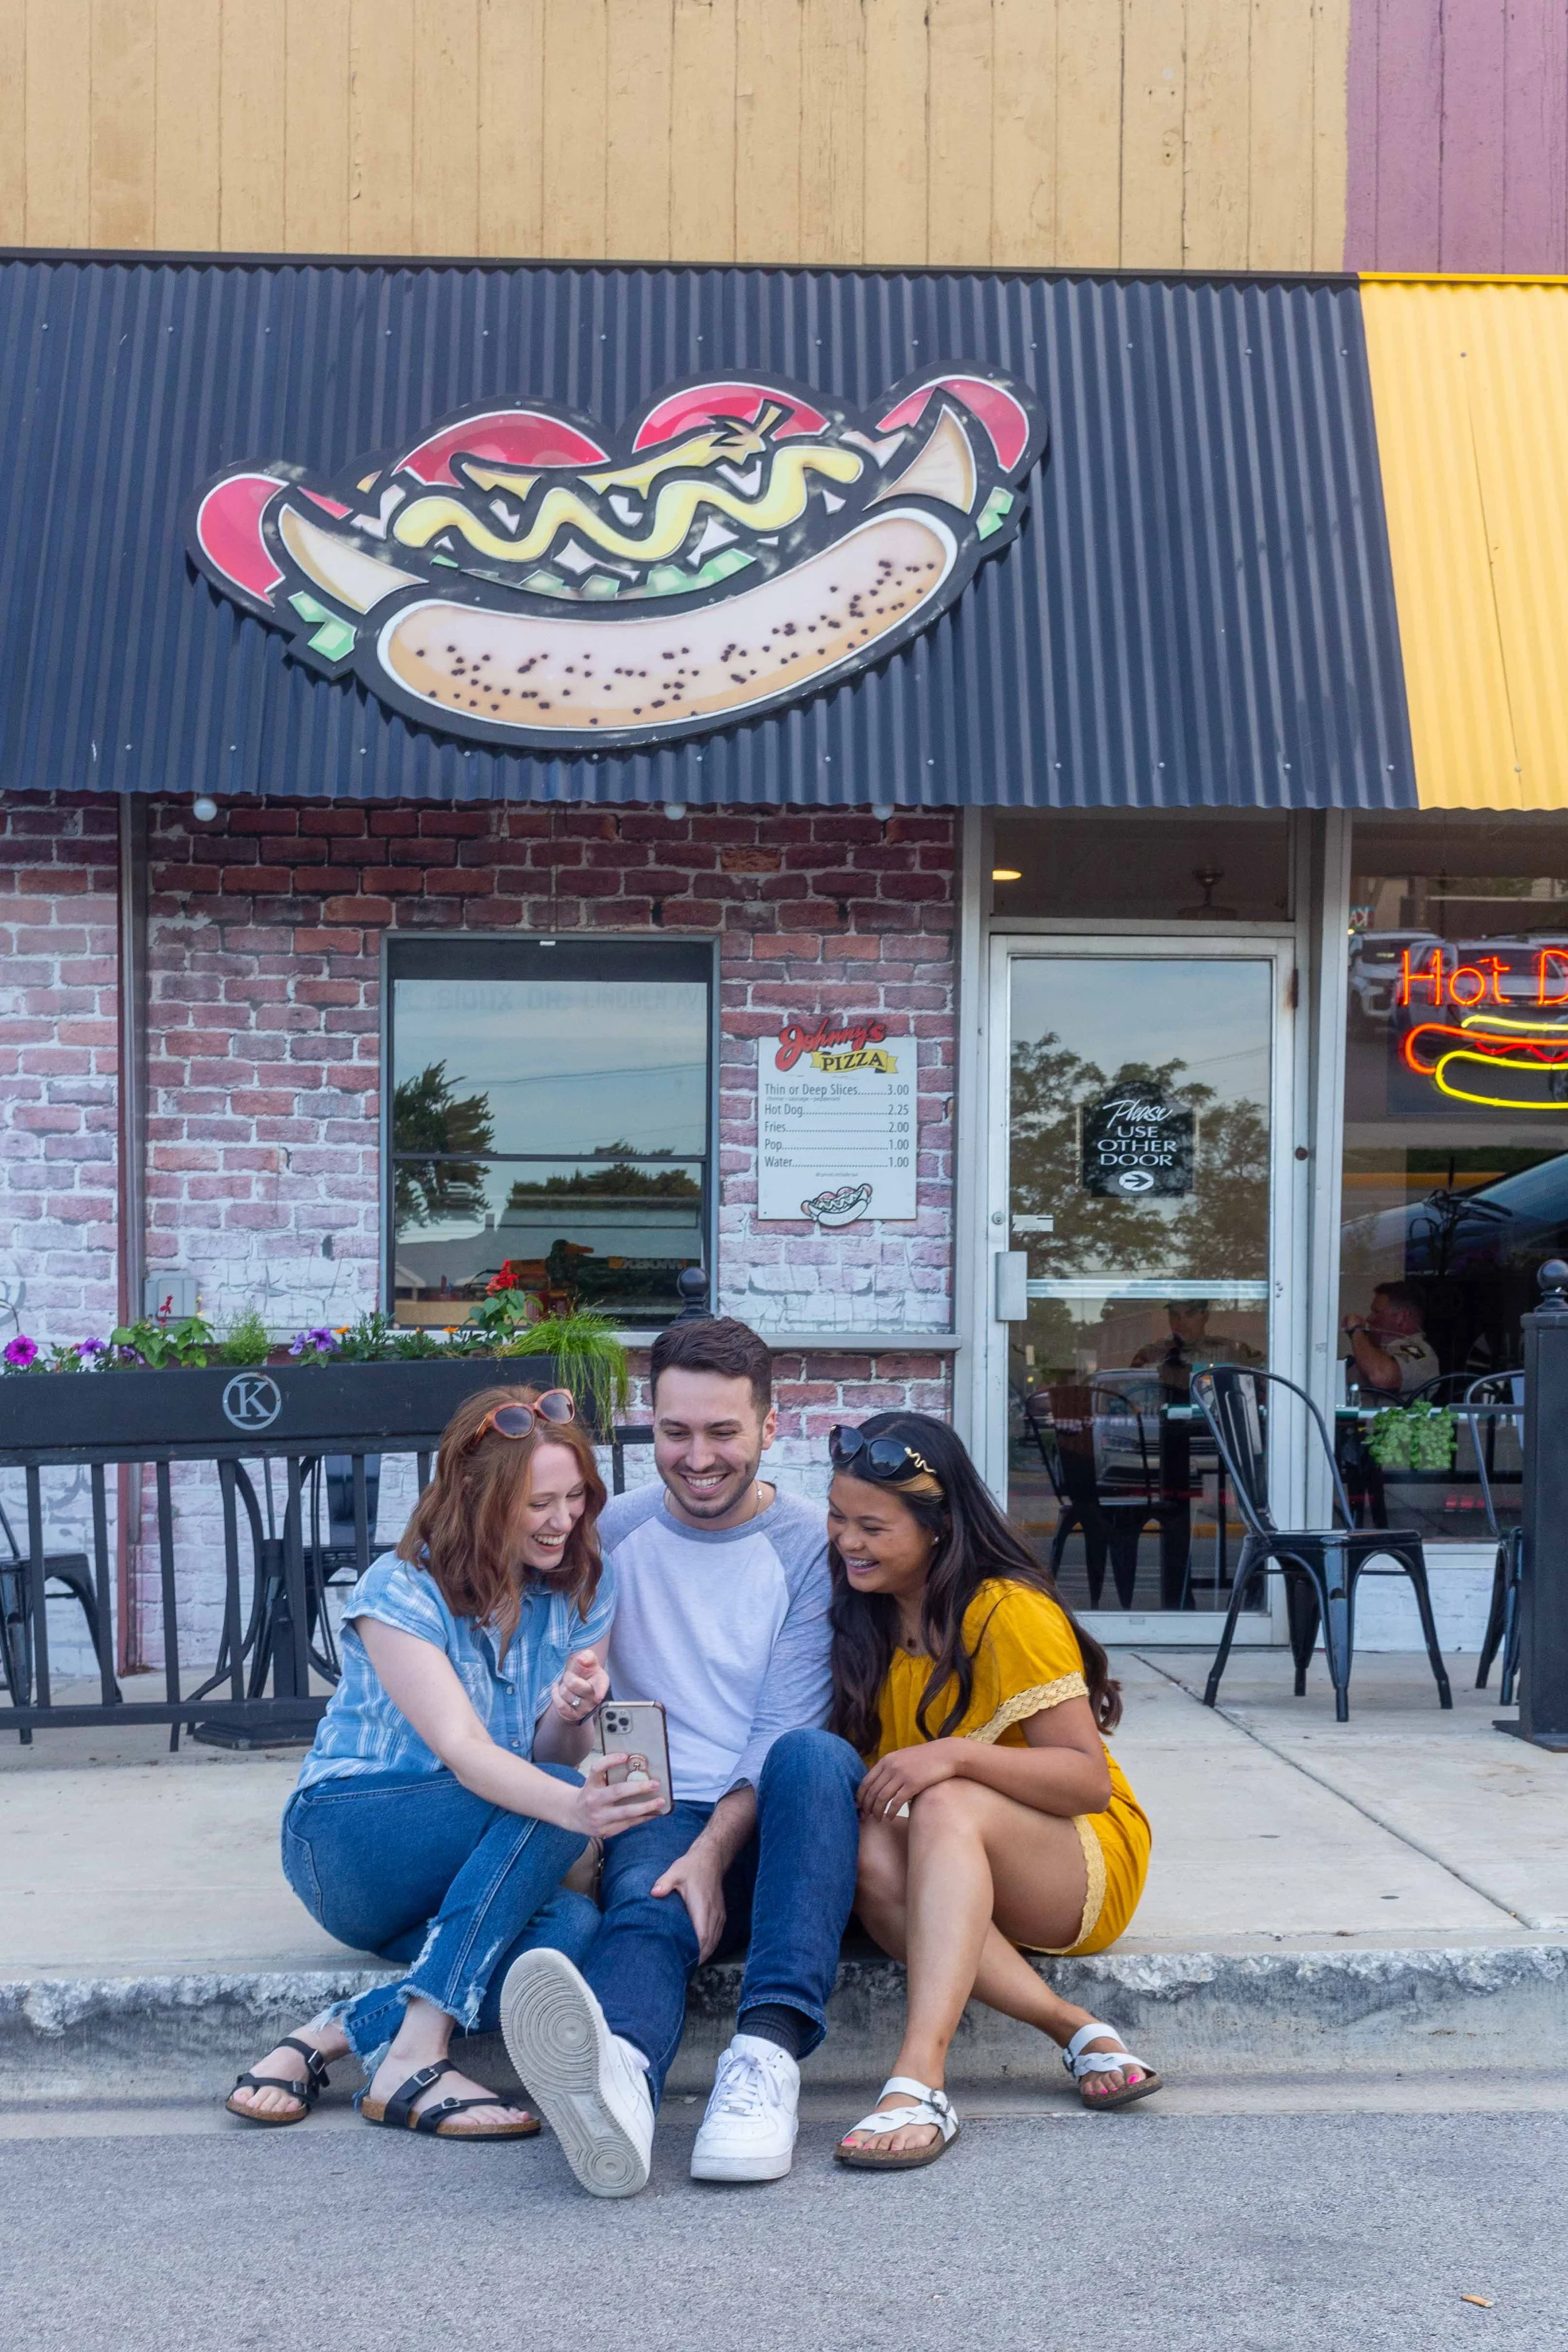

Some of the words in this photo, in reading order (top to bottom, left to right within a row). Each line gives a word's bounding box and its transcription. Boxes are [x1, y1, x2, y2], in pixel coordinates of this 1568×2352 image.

[1403, 948, 1511, 1006] Hot
[775, 1017, 886, 1071] Johnny's
[821, 1052, 884, 1071] PIZZA
[765, 1084, 785, 1095] Thin
[789, 1086, 799, 1095] or
[802, 1084, 827, 1097] Deep
[830, 1084, 858, 1095] Slices
[887, 1084, 909, 1095] 3.00
[765, 1104, 781, 1115] Hot
[784, 1104, 803, 1118] Dog
[887, 1104, 909, 1115] 2.25
[1103, 1099, 1173, 1129] Please
[765, 1121, 786, 1132] Fries
[888, 1121, 909, 1133] 2.00
[1117, 1126, 1158, 1138] USE
[765, 1138, 783, 1152] Pop
[888, 1139, 909, 1150] 1.00
[1098, 1140, 1177, 1152] OTHER
[764, 1156, 793, 1167] Water
[888, 1157, 909, 1168] 1.00
[1100, 1153, 1173, 1167] DOOR
[233, 1382, 273, 1417] K
